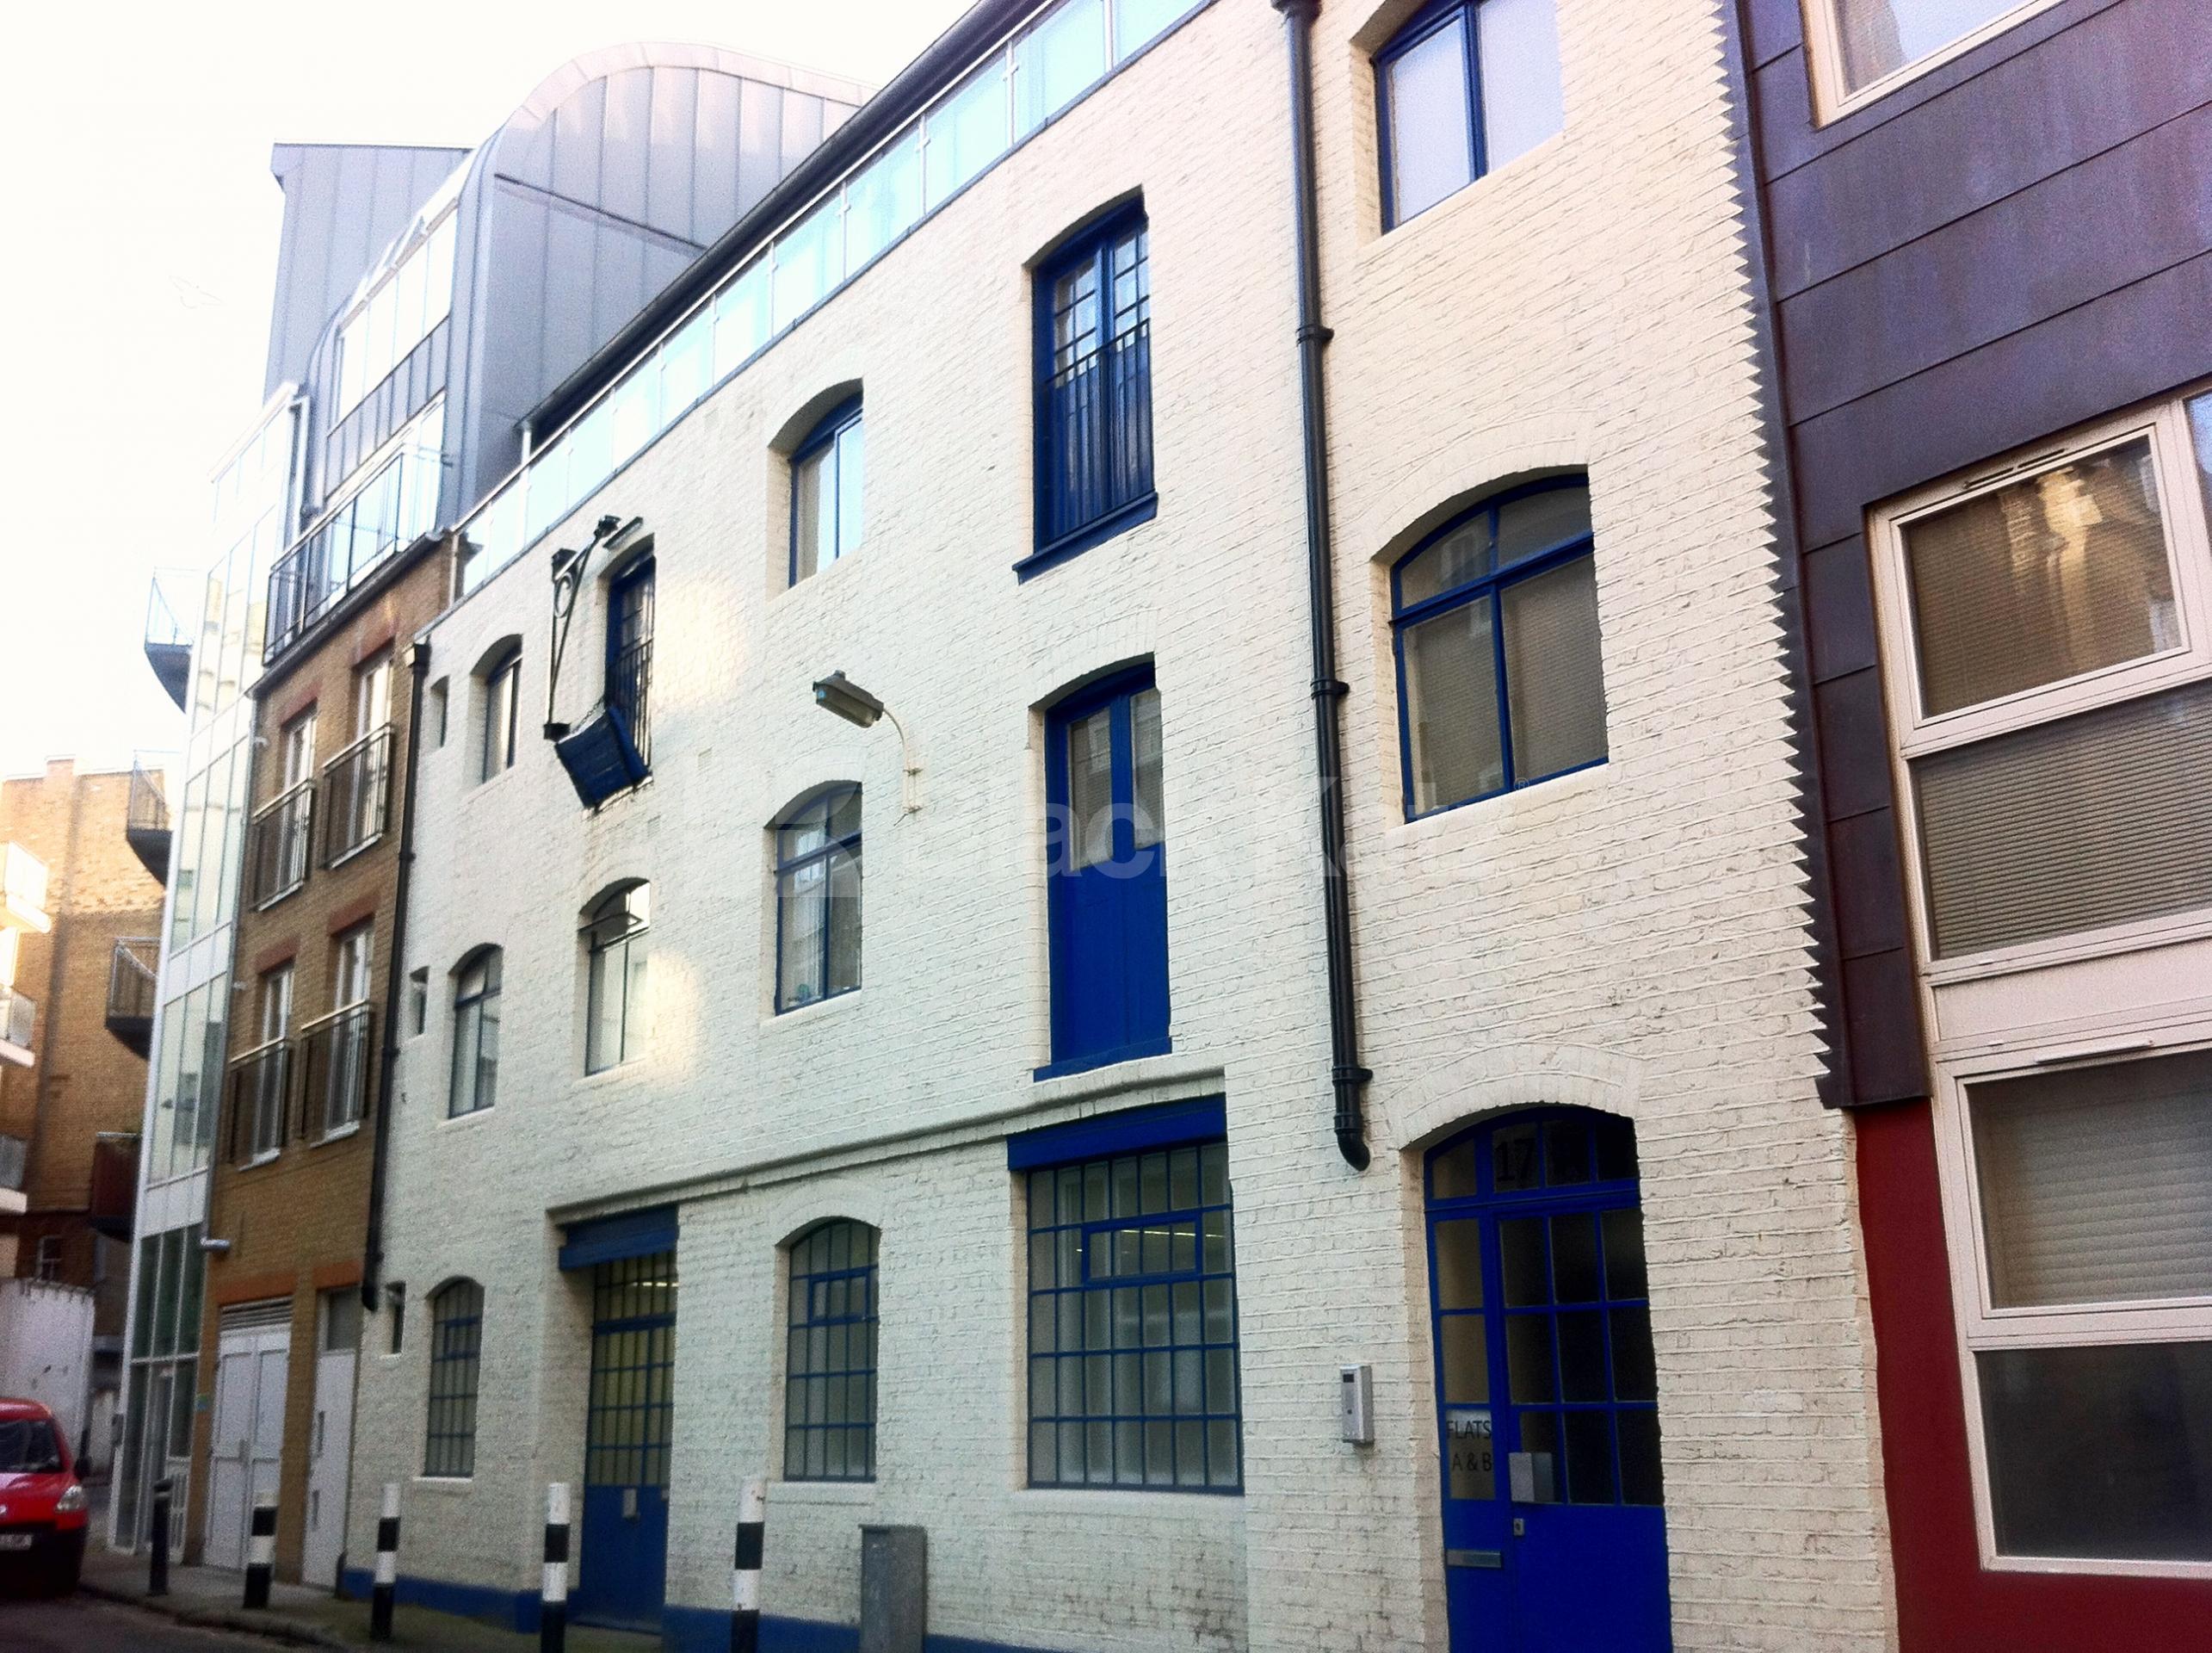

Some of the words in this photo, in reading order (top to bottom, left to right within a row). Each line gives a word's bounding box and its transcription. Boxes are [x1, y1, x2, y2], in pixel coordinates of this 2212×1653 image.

[1495, 1137, 1535, 1182] 17
[1446, 1420, 1492, 1439] FLATS
[1452, 1452, 1462, 1470] A
[1467, 1452, 1479, 1470] &
[1482, 1452, 1492, 1471] B
